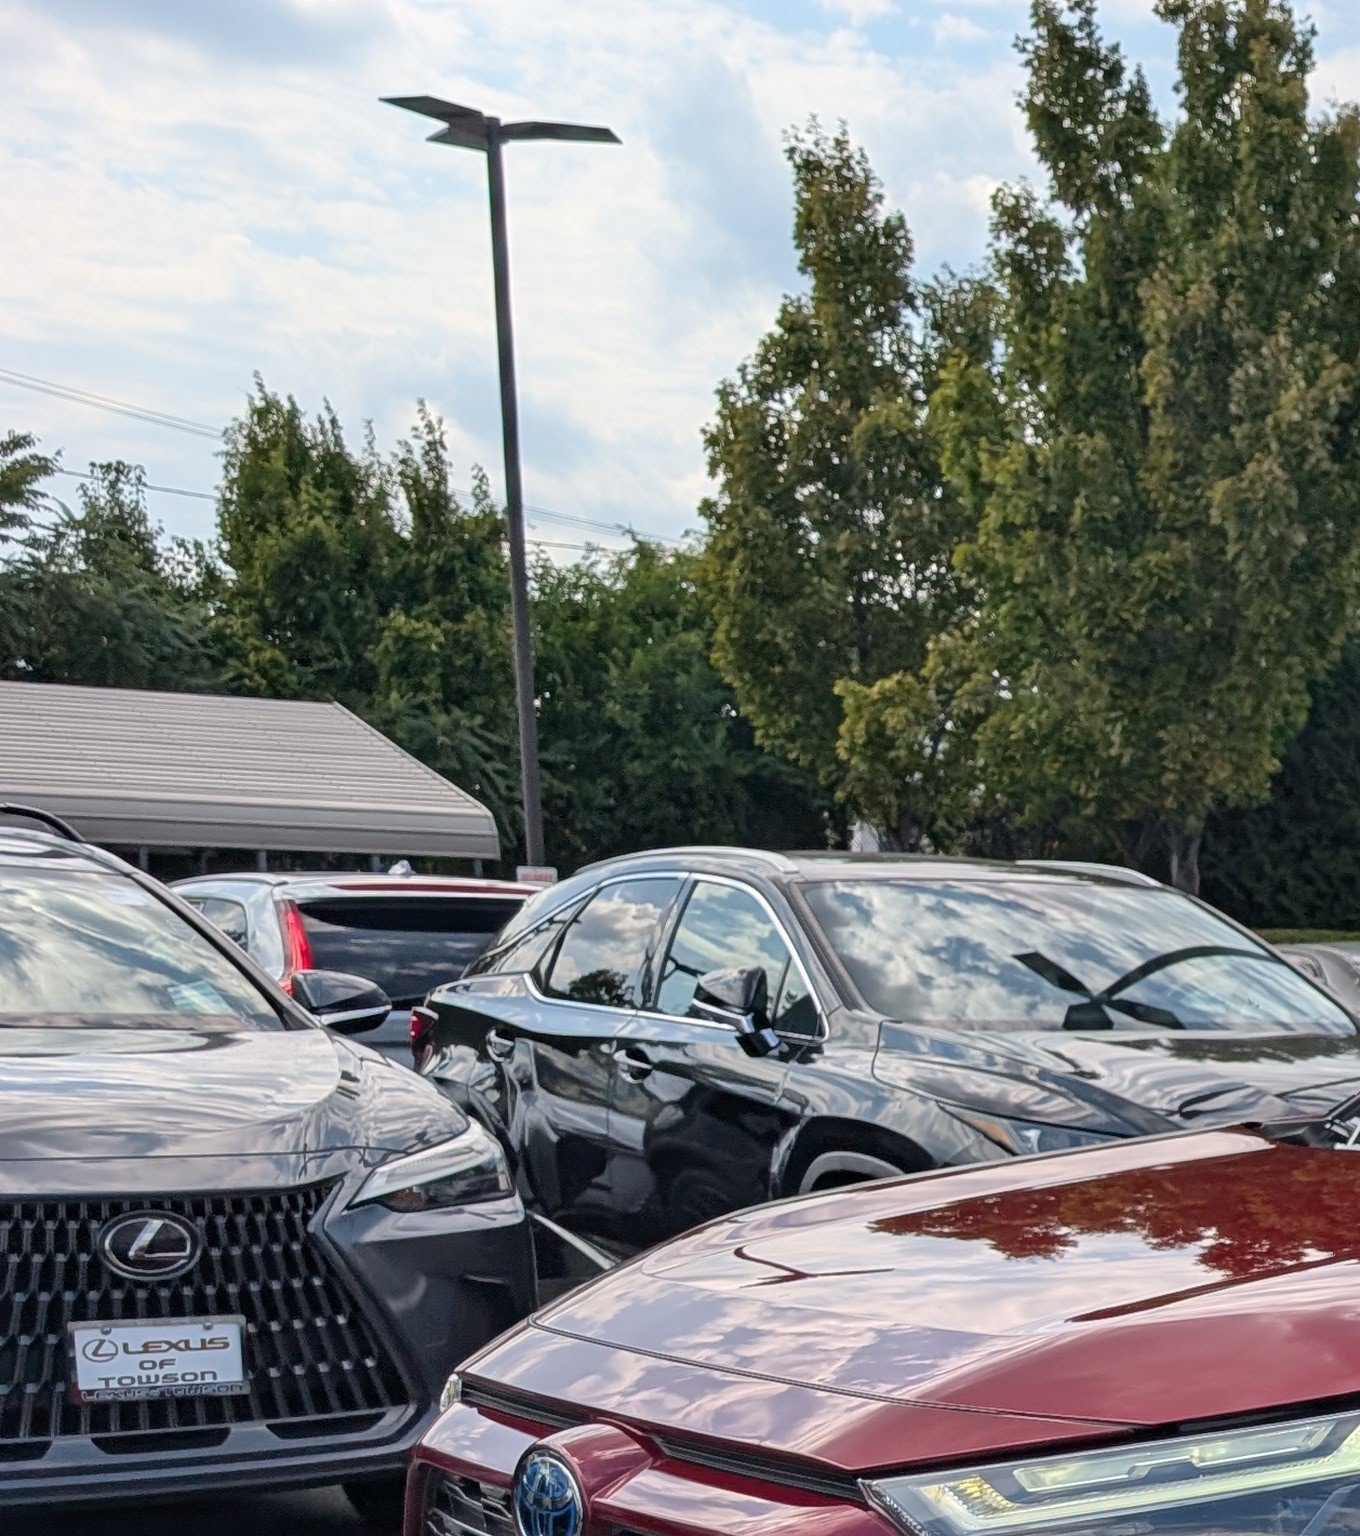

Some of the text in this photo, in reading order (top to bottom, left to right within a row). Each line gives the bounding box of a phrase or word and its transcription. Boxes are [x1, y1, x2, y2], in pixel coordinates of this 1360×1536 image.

[123, 1337, 230, 1354] LEXUS
[139, 1358, 176, 1370] OF
[98, 1371, 217, 1387] TOWSON
